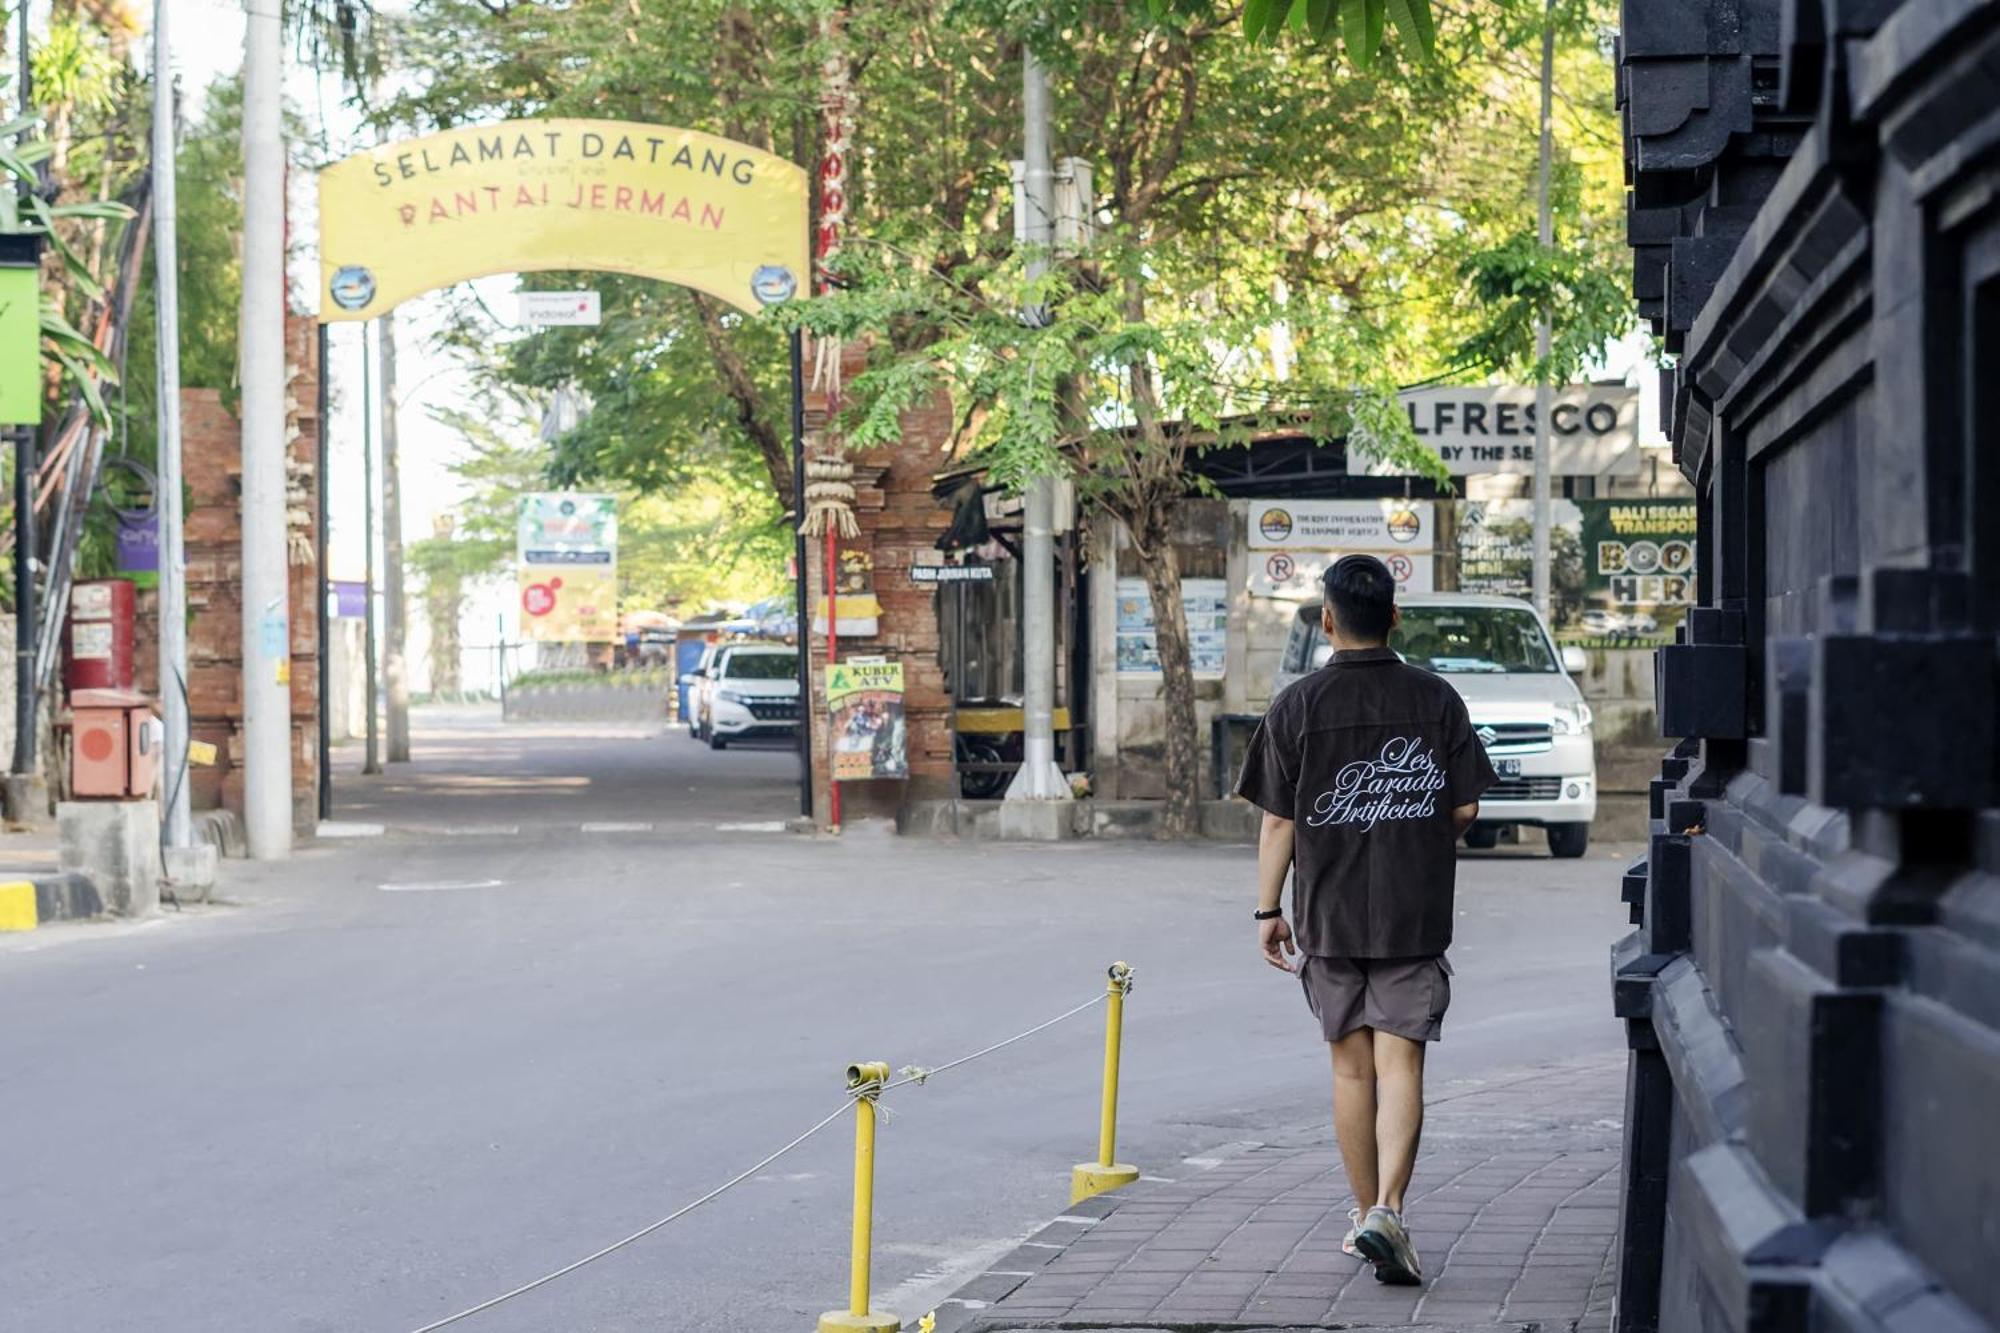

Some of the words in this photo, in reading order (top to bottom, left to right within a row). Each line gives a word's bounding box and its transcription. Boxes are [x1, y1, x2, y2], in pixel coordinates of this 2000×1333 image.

[374, 132, 562, 188] SELAMAT
[582, 133, 755, 185] DATANG
[571, 184, 726, 230] JERMAN
[1380, 401, 1618, 436] LFRESCO
[1441, 446, 1464, 461] BY
[1471, 446, 1505, 461] THE
[1511, 446, 1535, 461] SE
[1598, 540, 1697, 575] BOO
[1610, 574, 1697, 605] HER
[852, 665, 899, 677] KUBER
[860, 676, 893, 686] ATV
[1376, 736, 1434, 773] Les
[1335, 760, 1446, 798] Paradis
[1306, 790, 1435, 833] Artificiels
